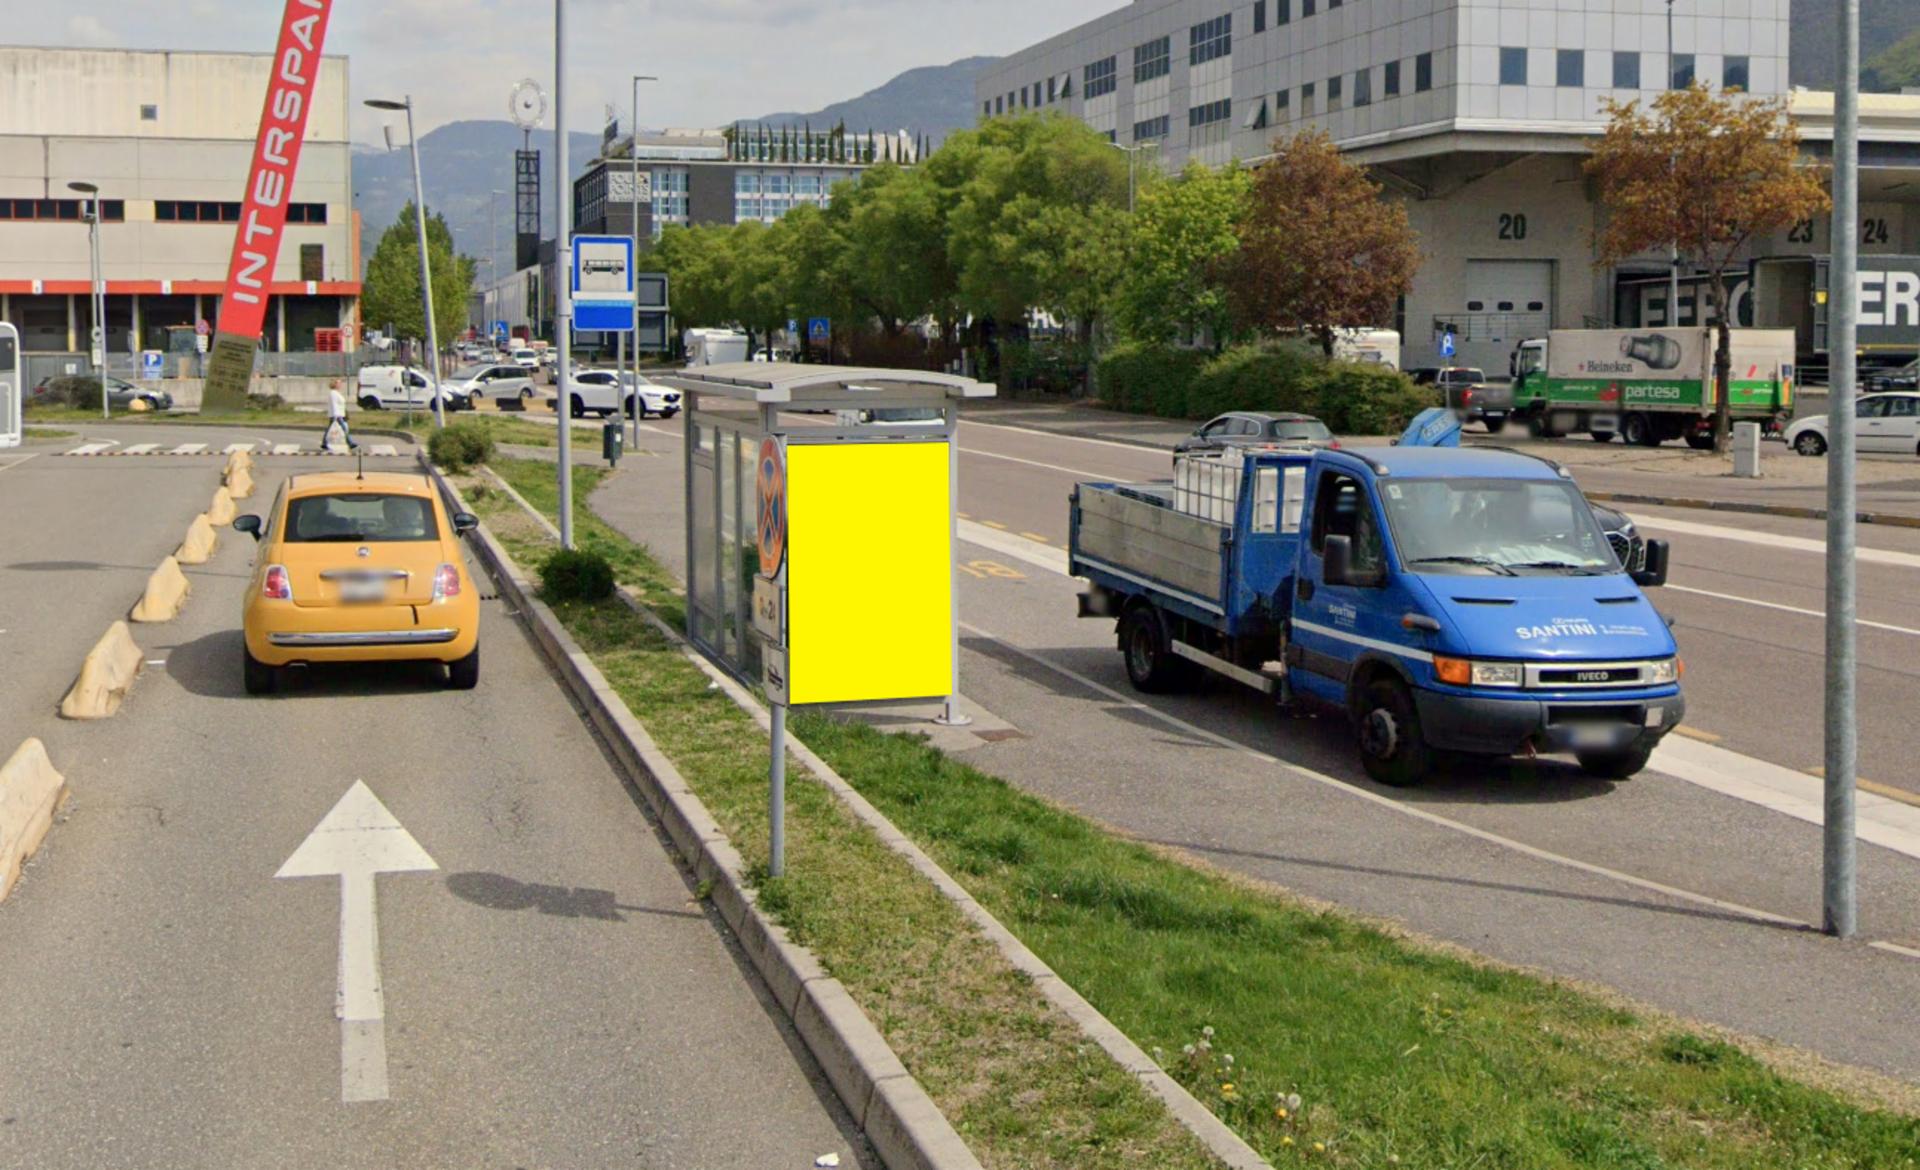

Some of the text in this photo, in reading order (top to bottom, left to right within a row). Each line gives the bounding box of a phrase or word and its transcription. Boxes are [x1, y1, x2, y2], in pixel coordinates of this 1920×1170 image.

[1499, 213, 1526, 240] 20
[1788, 218, 1814, 243] 23
[1863, 218, 1889, 243] 24
[1443, 334, 1452, 354] P
[149, 354, 158, 366] P
[1586, 361, 1633, 373] Heineken
[1625, 386, 1680, 400] partesa
[1516, 624, 1597, 639] SANTINI
[1577, 672, 1608, 681] IVECO
